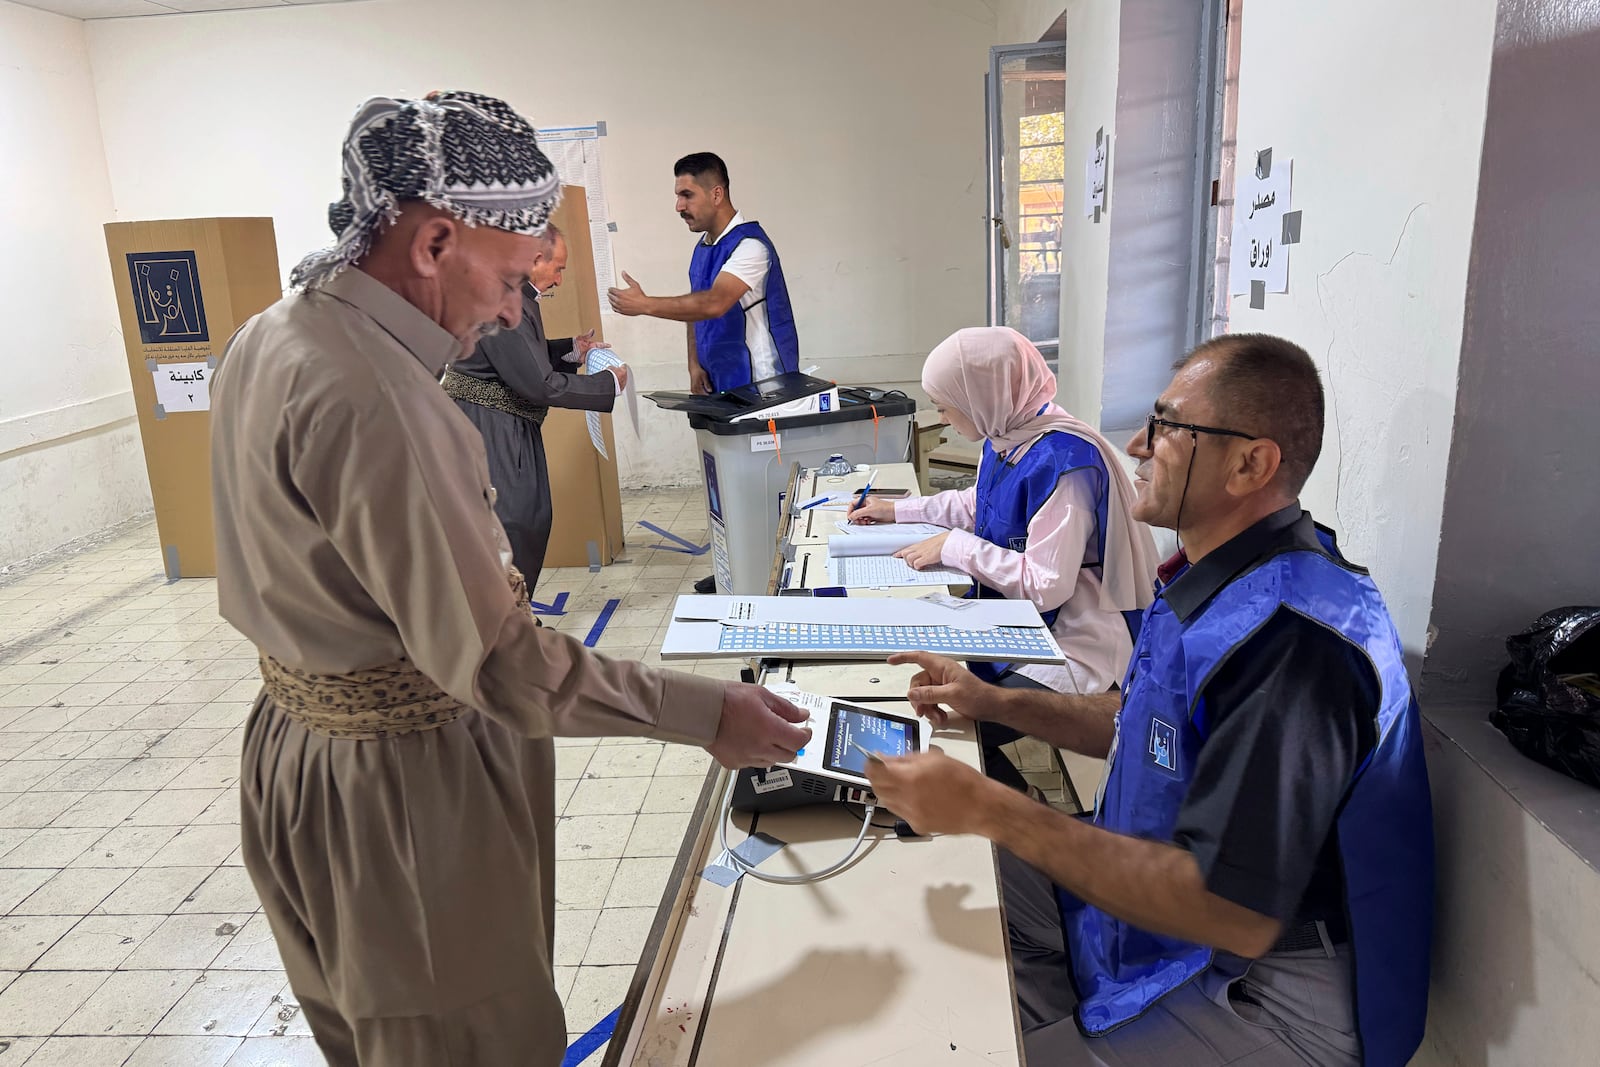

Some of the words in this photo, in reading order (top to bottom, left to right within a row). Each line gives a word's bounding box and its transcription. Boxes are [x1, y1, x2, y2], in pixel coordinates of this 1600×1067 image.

[1248, 190, 1276, 220] مصدر
[1249, 237, 1273, 268] اوراق
[169, 369, 205, 384] كابينة
[187, 393, 194, 403] ٢
